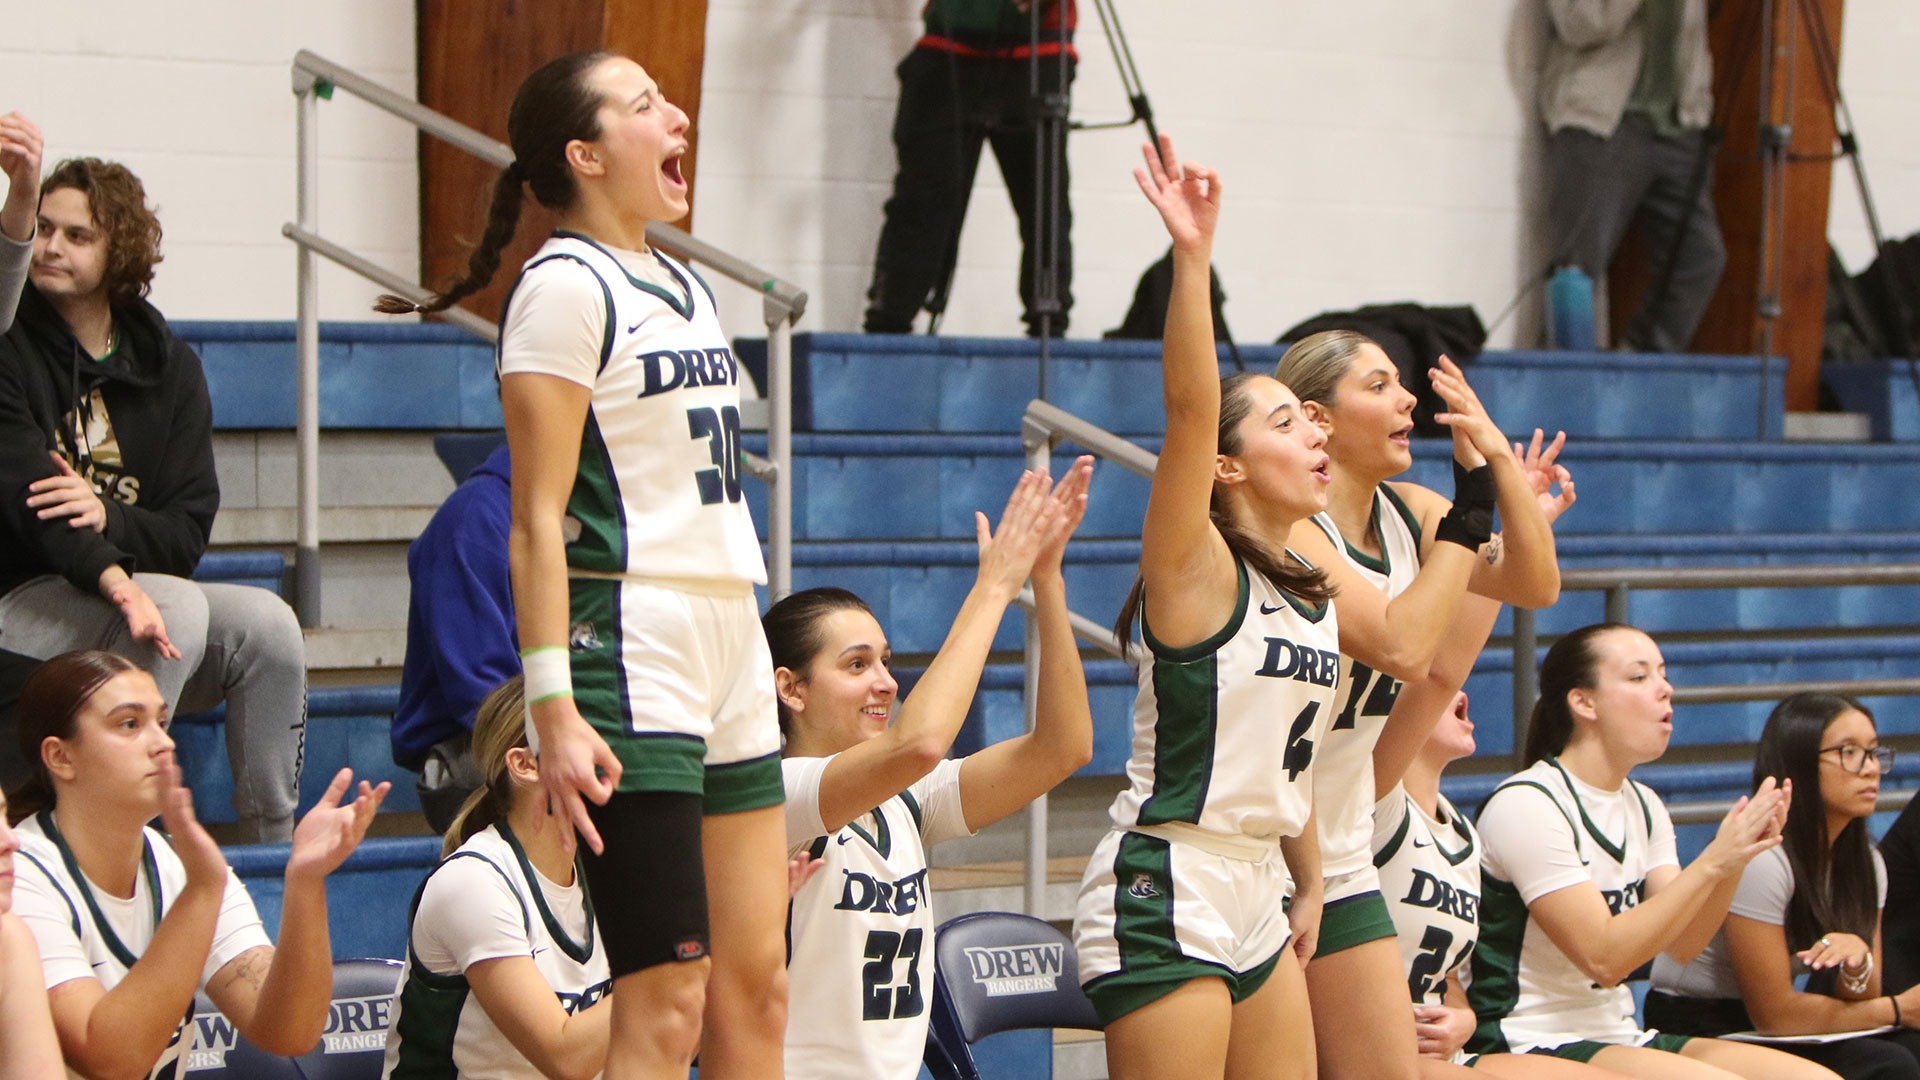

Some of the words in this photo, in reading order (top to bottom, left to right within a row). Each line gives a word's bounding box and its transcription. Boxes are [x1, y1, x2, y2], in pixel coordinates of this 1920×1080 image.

[686, 405, 742, 506] 30
[1254, 636, 1340, 691] DRE
[1282, 700, 1321, 783] 4
[1400, 868, 1480, 926] DRE
[862, 927, 925, 1022] 23
[966, 945, 1062, 980] DREW
[988, 976, 1054, 994] RANGERS
[328, 1033, 388, 1051] RANGE
